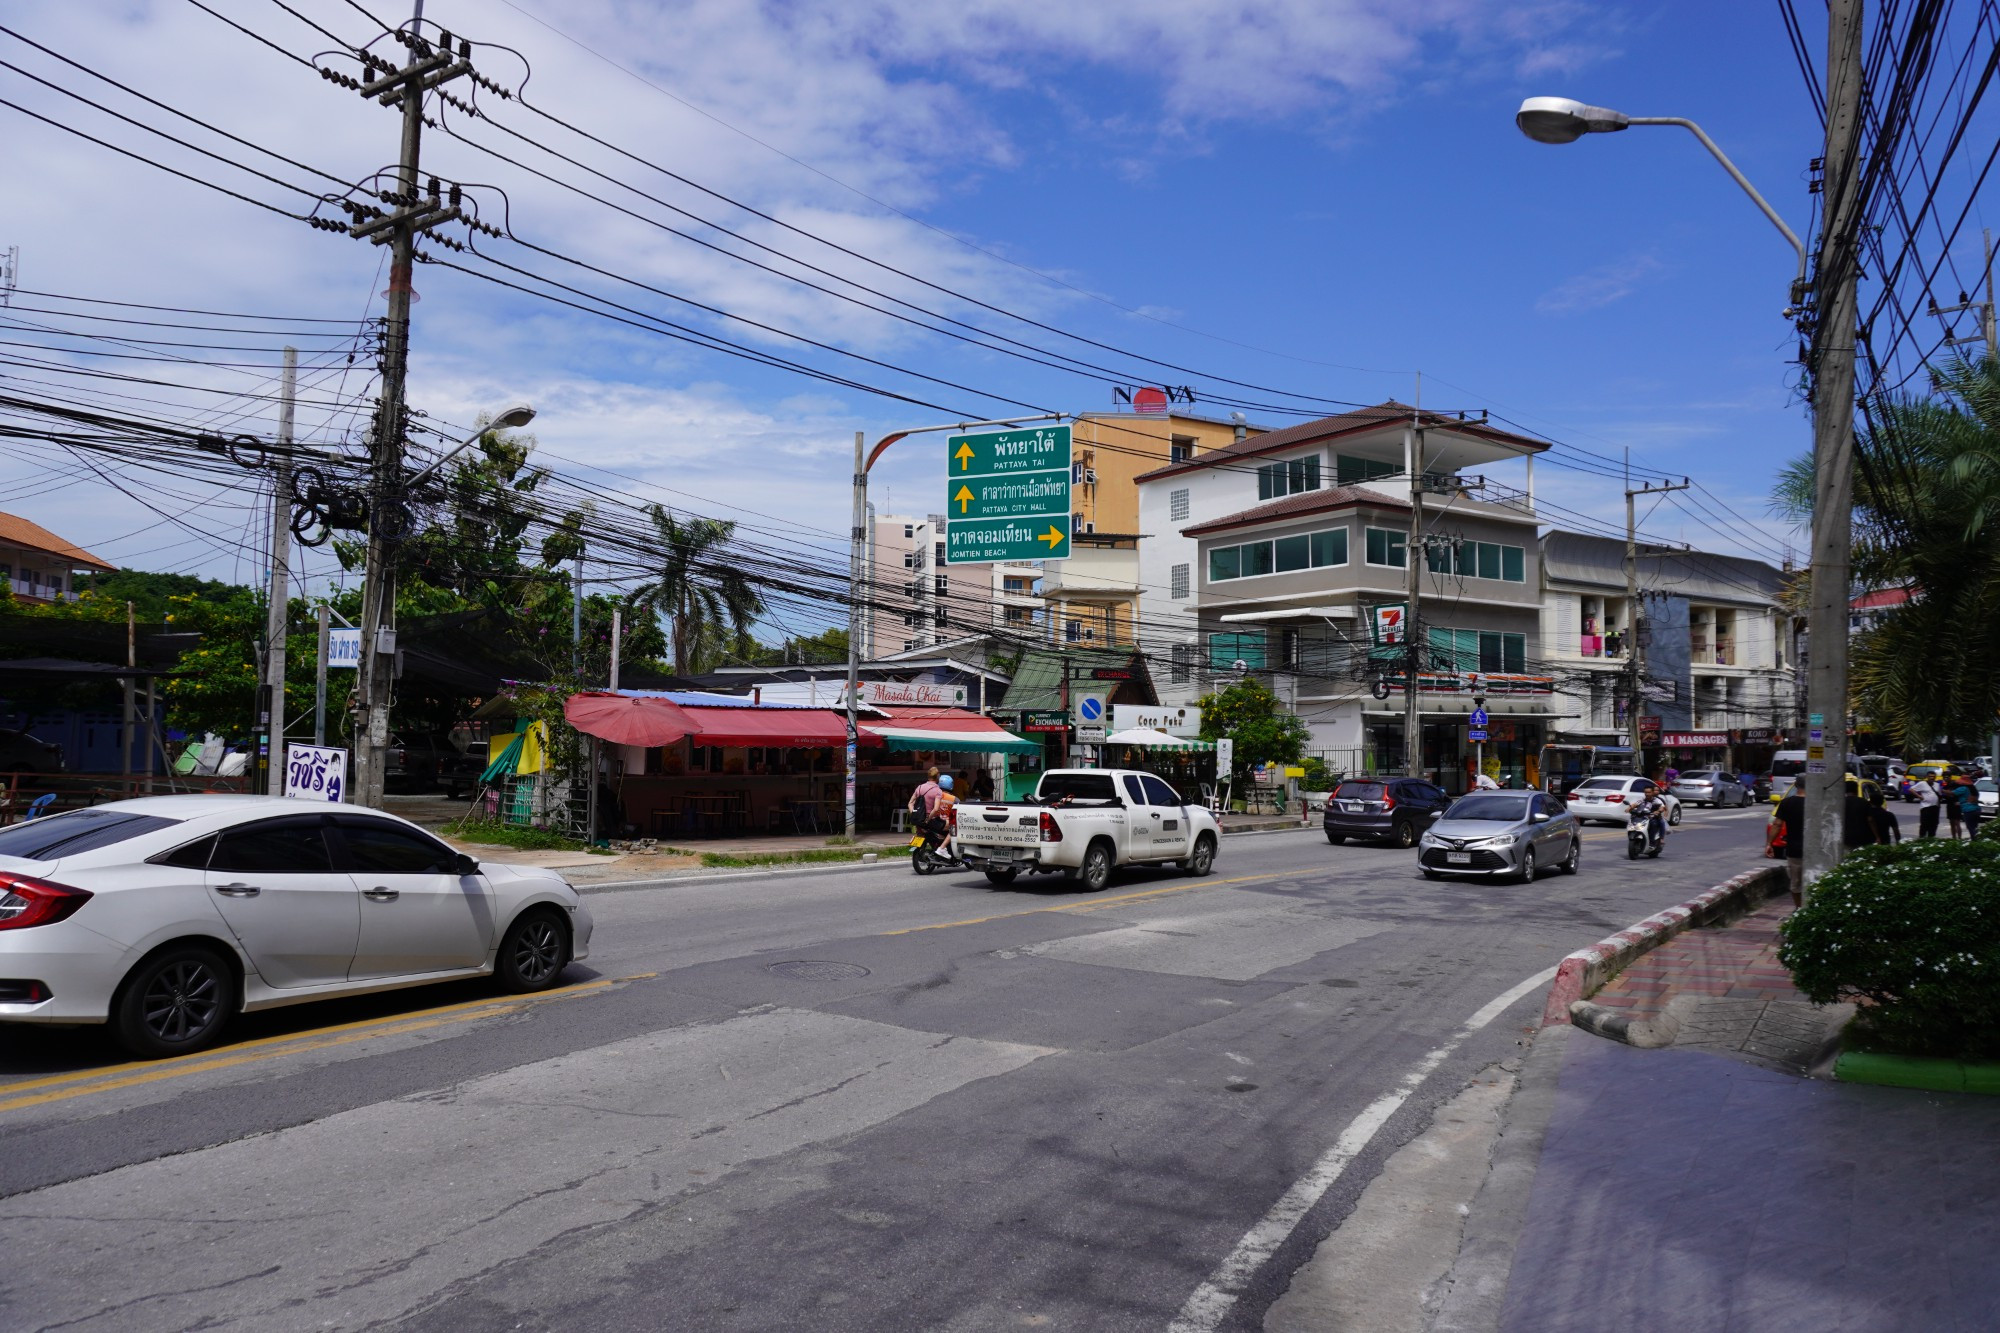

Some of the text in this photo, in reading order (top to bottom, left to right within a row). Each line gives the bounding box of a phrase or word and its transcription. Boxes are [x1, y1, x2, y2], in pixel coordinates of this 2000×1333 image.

[994, 430, 1056, 457] พัทยาใต้
[993, 458, 1045, 470] PATTAYA TAI
[982, 477, 1066, 501] ศาลาว่าการเมืองพัทยา
[982, 503, 1047, 514] PATTAYA CITY HALL
[951, 522, 1032, 546] หาดจอมเทียน
[951, 548, 1007, 558] JOMTIEN BEACH
[873, 683, 943, 704] Masala Chai
[1035, 718, 1064, 726] EXCHANGE
[1678, 735, 1722, 745] MASSAGE
